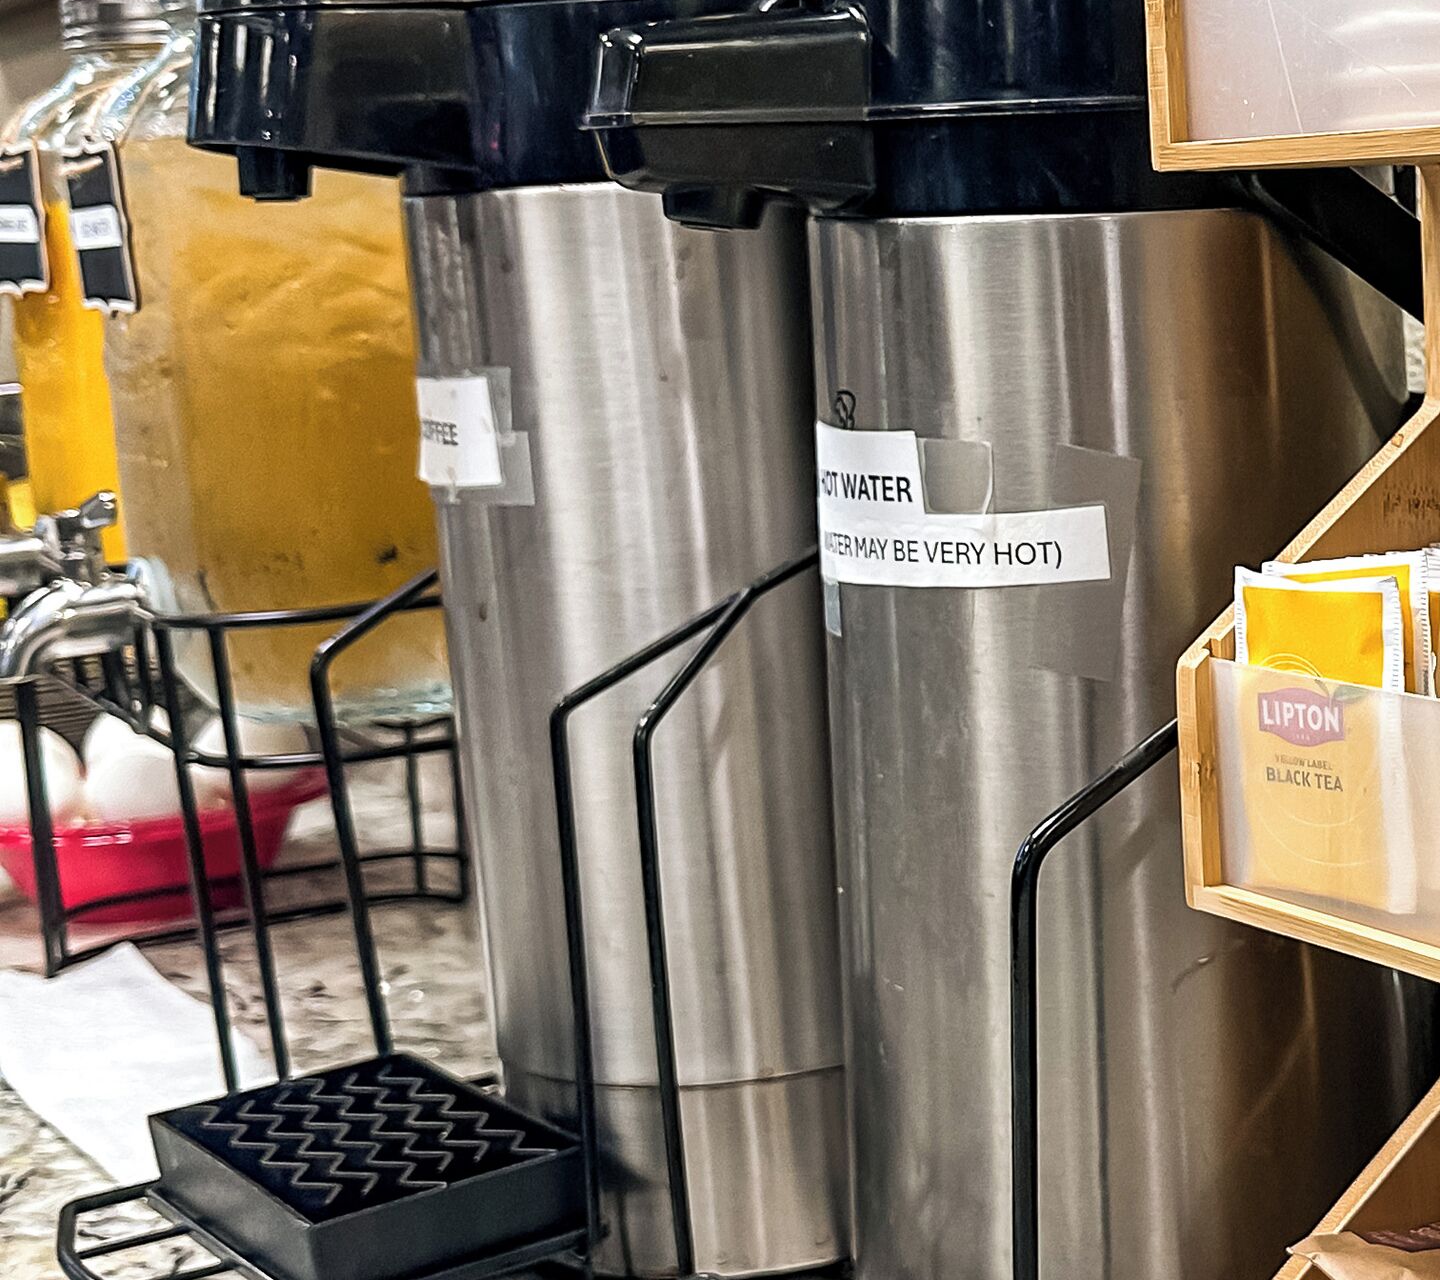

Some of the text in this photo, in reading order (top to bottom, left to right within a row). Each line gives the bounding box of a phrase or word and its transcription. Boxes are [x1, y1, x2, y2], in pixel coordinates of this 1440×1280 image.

[841, 472, 913, 503] WATER
[854, 536, 888, 560] MAY
[893, 539, 919, 563] BE
[923, 540, 986, 566] VERY
[993, 540, 1063, 570] HOT)
[1262, 698, 1341, 733] LIPTON
[1266, 766, 1344, 793] BLACK TEA
